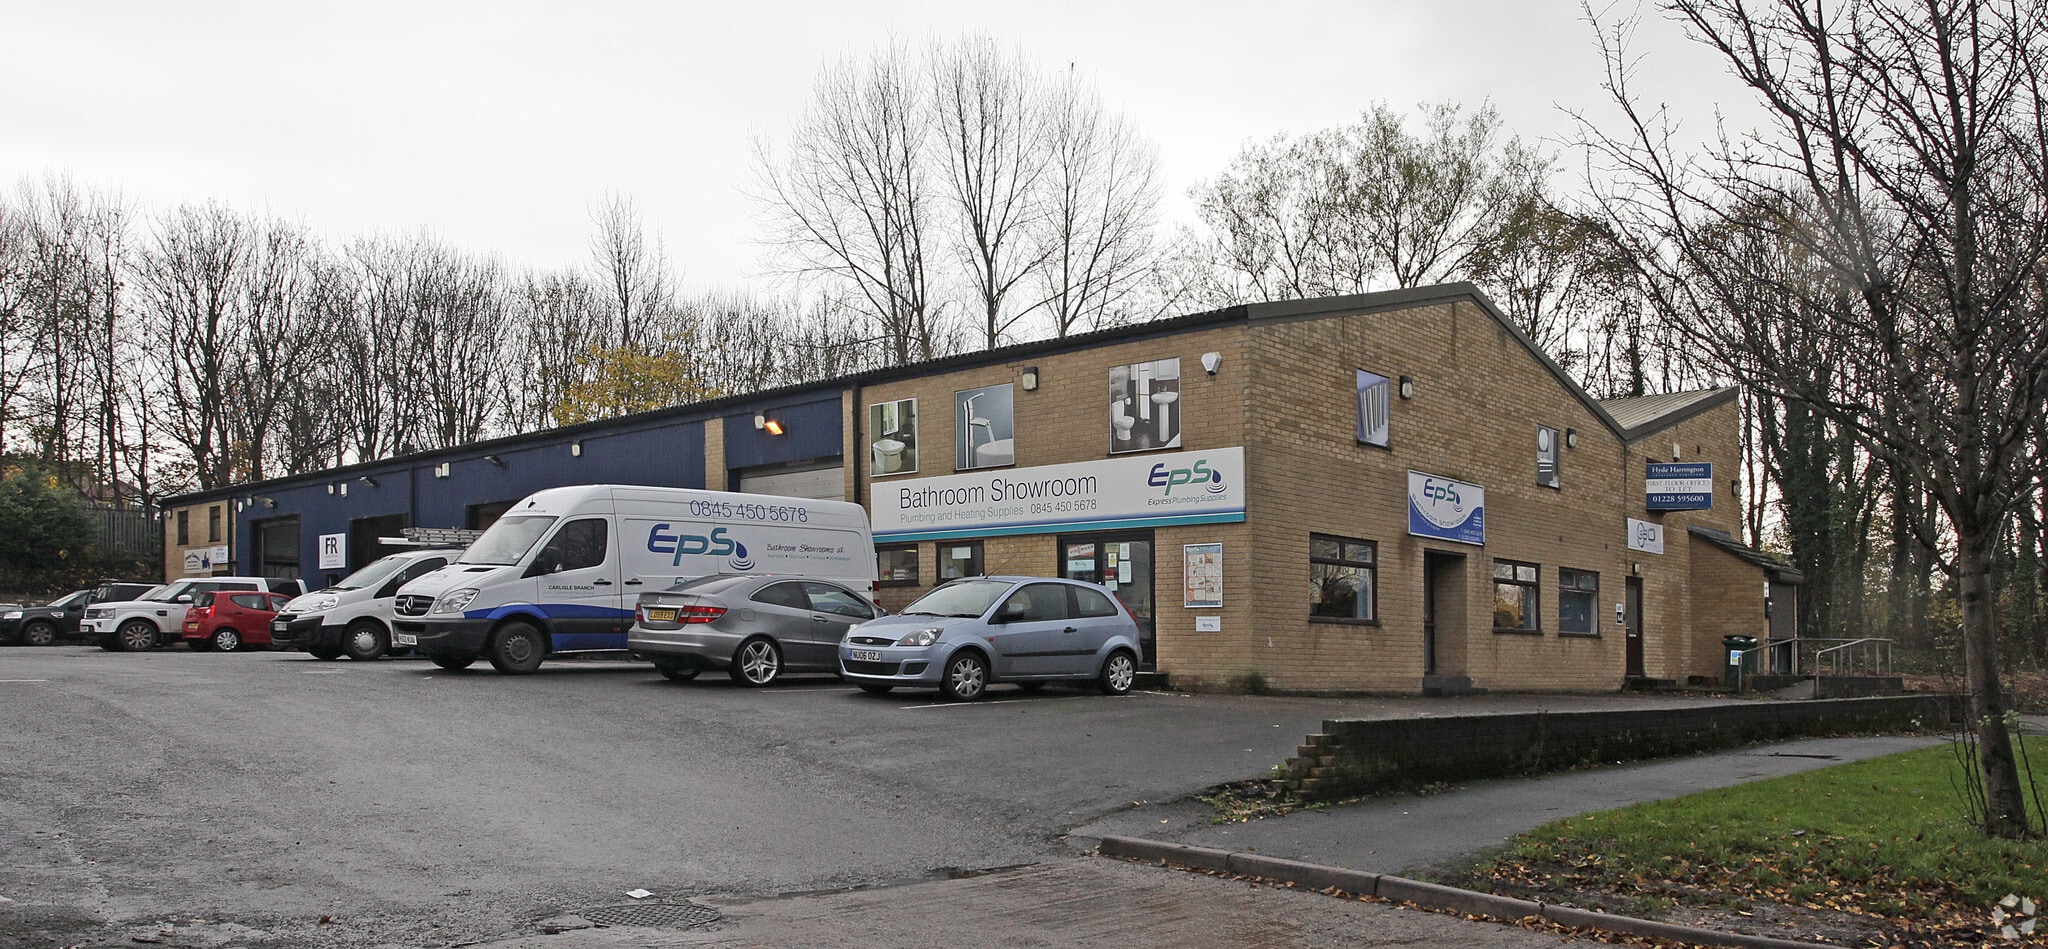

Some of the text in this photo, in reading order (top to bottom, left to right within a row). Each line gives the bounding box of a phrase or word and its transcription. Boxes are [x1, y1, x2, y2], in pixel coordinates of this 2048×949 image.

[1651, 466, 1704, 474] Hyde Harrington
[900, 475, 1097, 509] Bathroom Showroom
[1652, 495, 1704, 503] 01228 595600
[689, 500, 808, 523] 0845 450 5678
[900, 499, 1097, 524] Plumbing and Heating Supplies 0845 450 5678
[325, 536, 338, 555] FR
[766, 543, 797, 552] Bathroom
[799, 544, 835, 554] Showrooms
